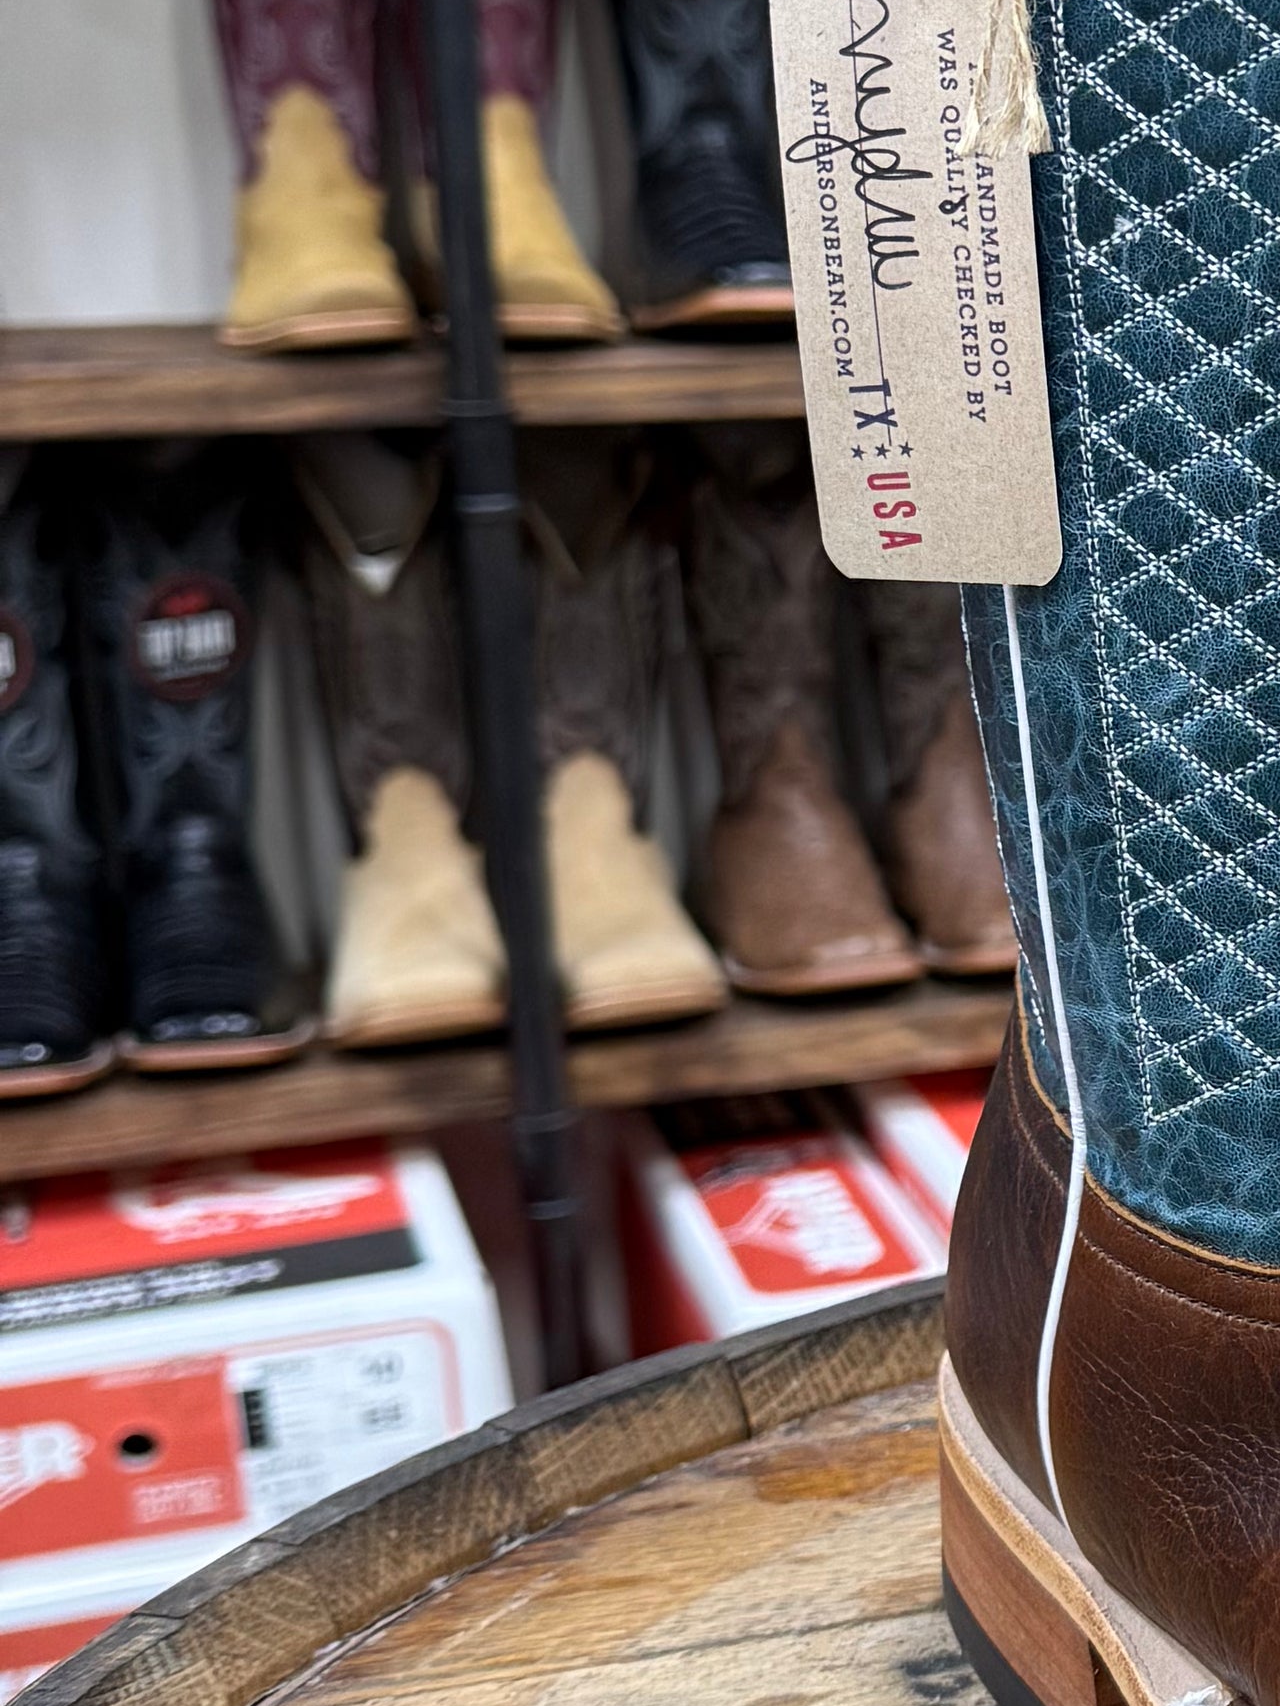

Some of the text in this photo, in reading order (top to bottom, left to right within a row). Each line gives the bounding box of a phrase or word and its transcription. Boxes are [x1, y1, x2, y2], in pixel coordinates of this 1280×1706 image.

[936, 28, 958, 91] WAS
[809, 77, 855, 378] ANDERSONBEAN.COM
[953, 244, 982, 378] CHECKED
[989, 320, 1012, 396] BOOT
[966, 390, 987, 424] BY
[849, 378, 923, 551] TX USA
